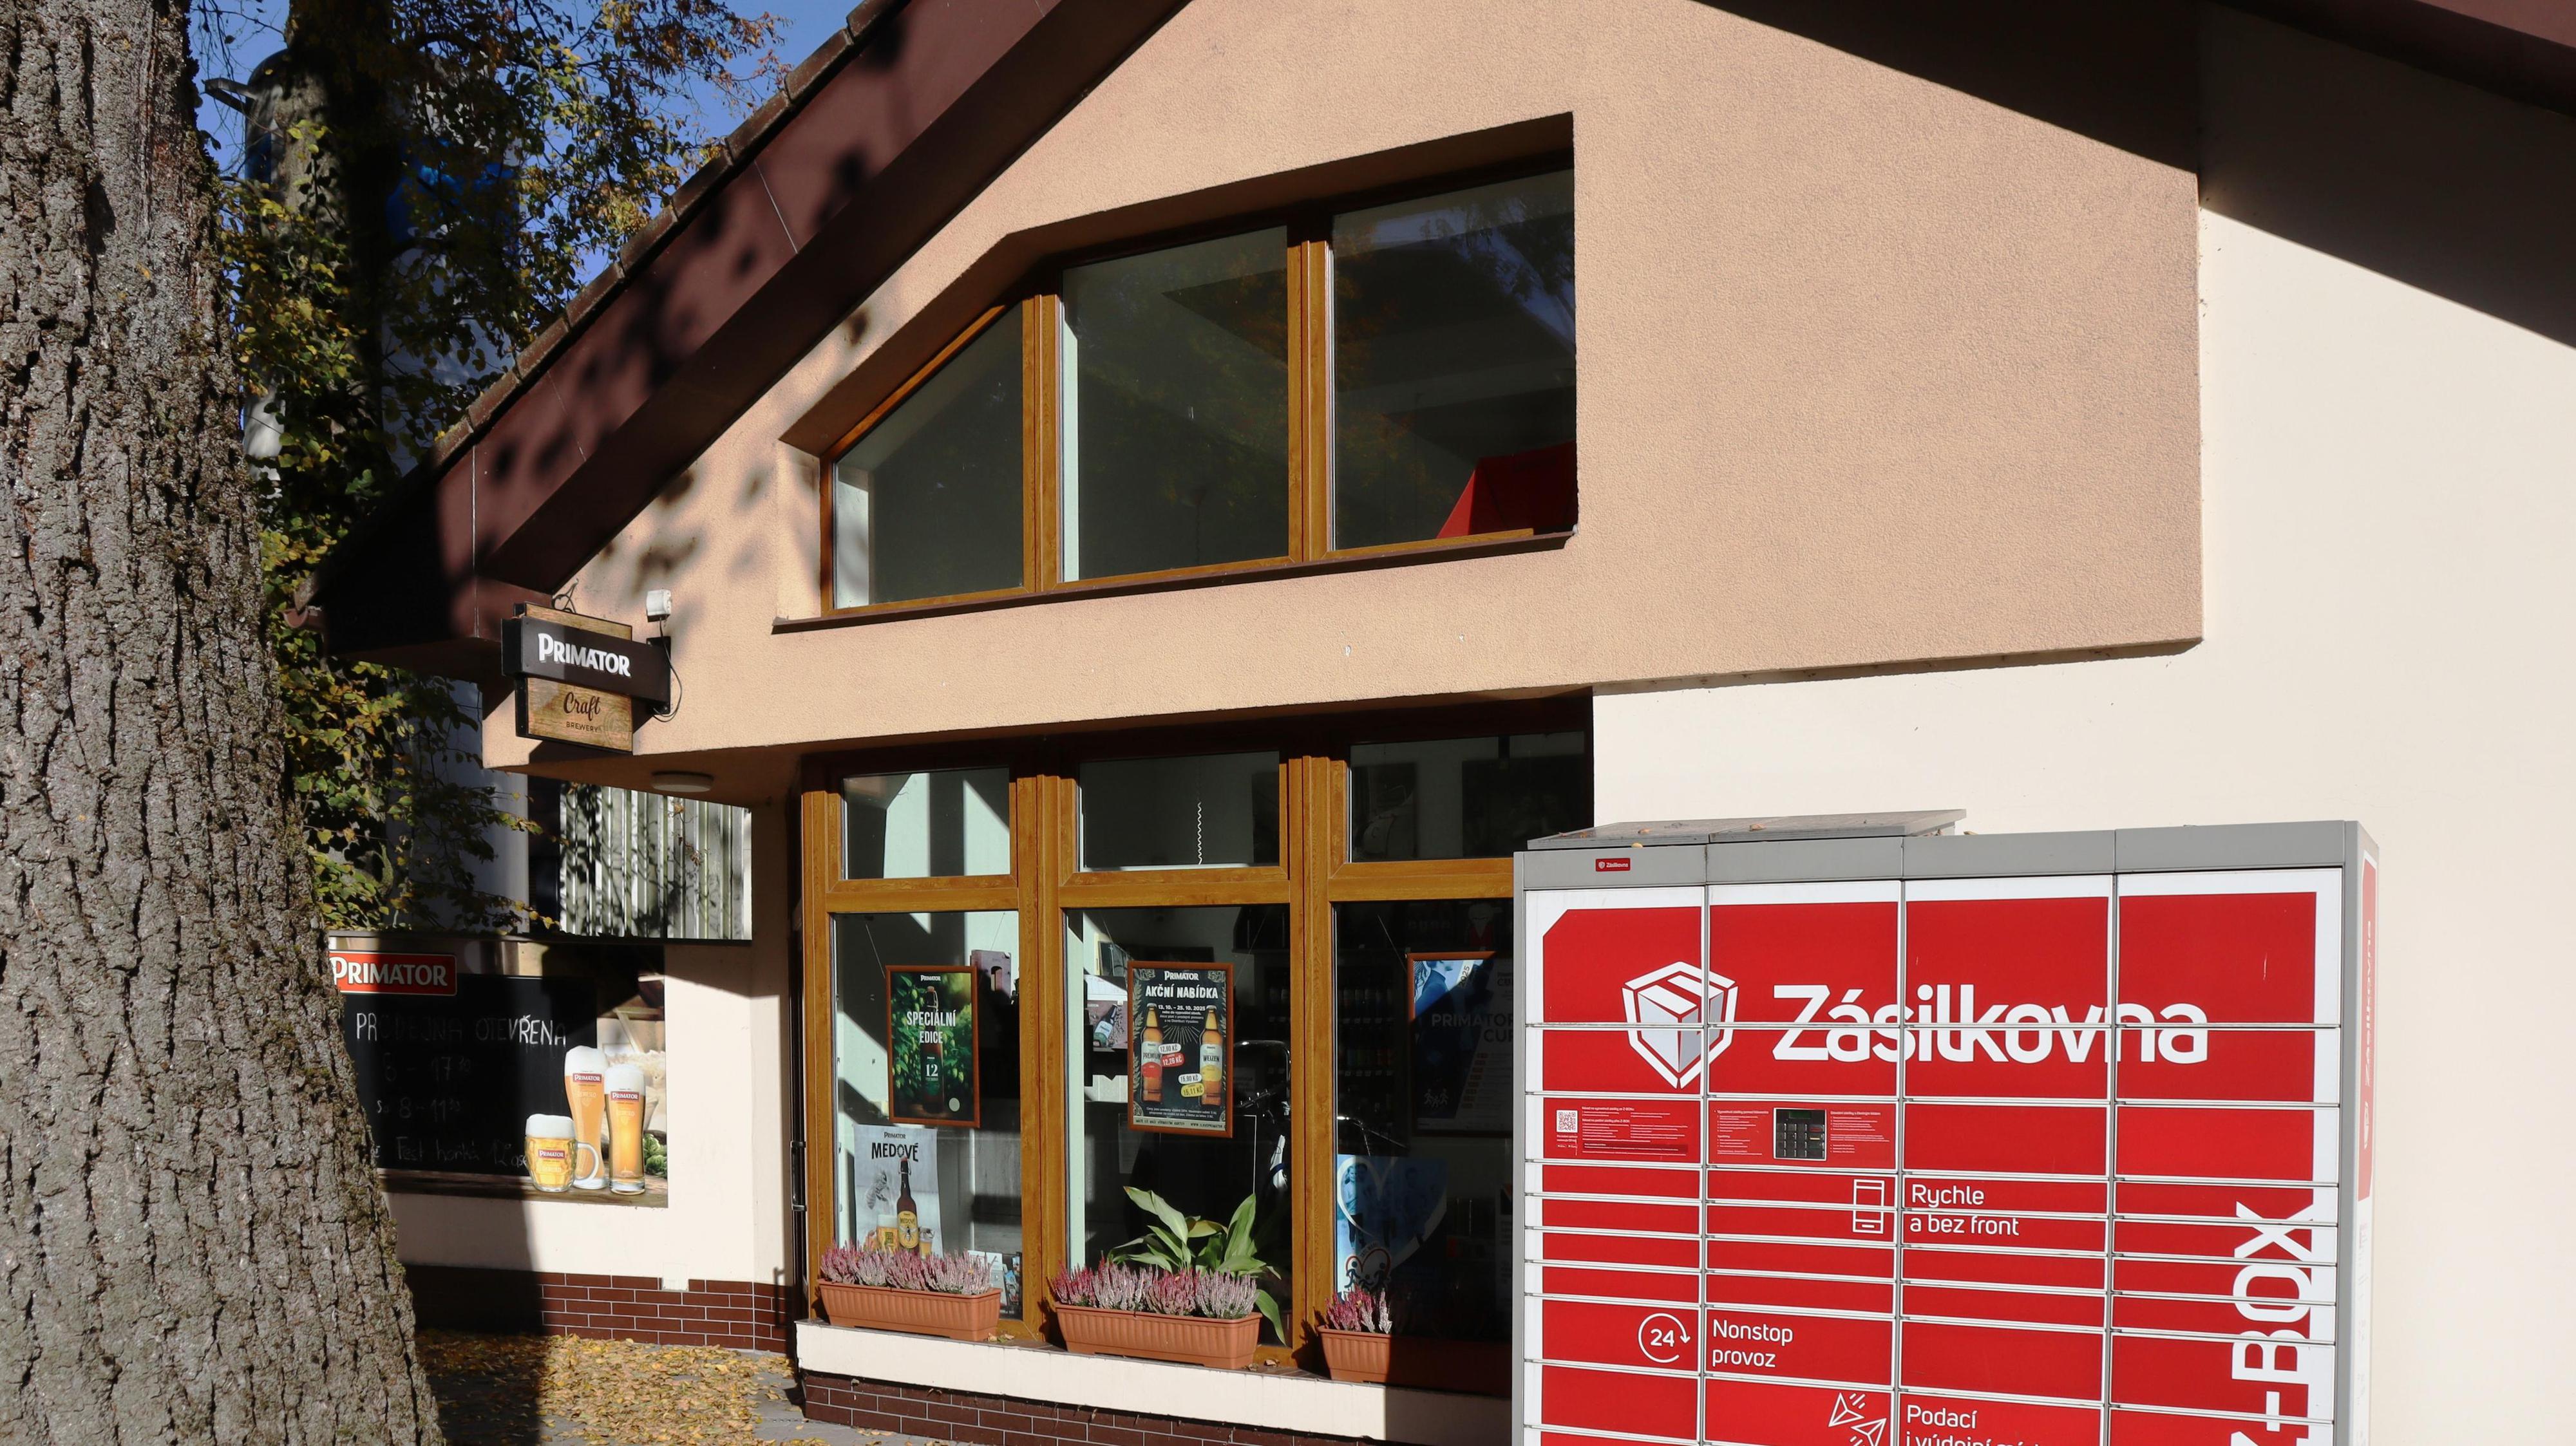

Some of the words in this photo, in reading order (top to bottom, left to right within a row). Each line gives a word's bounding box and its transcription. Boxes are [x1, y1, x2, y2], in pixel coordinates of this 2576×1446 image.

[564, 691, 600, 721] Craft
[566, 722, 598, 733] BREWERY
[1145, 984, 1175, 998] AKČNÍ
[1177, 984, 1218, 999] NABÍDKA
[906, 1009, 957, 1027] SPECIÁLNÍ
[1772, 984, 2208, 1064] Zásilkovna
[356, 1013, 463, 1042] PRODEJNA
[475, 1014, 567, 1047] OTEVŘENA
[920, 1031, 943, 1044] EDICE
[925, 1064, 939, 1076] 12
[871, 1142, 919, 1162] MEDOVÉ
[1911, 1183, 1985, 1208] Rychle
[1909, 1218, 1922, 1232] a
[1927, 1213, 1965, 1234] bez
[1971, 1215, 2020, 1236] front
[1650, 1328, 1675, 1347] 24
[1712, 1319, 1794, 1347] Nonstop
[1712, 1348, 1776, 1368] provoz
[1907, 1404, 1978, 1429] Podací
